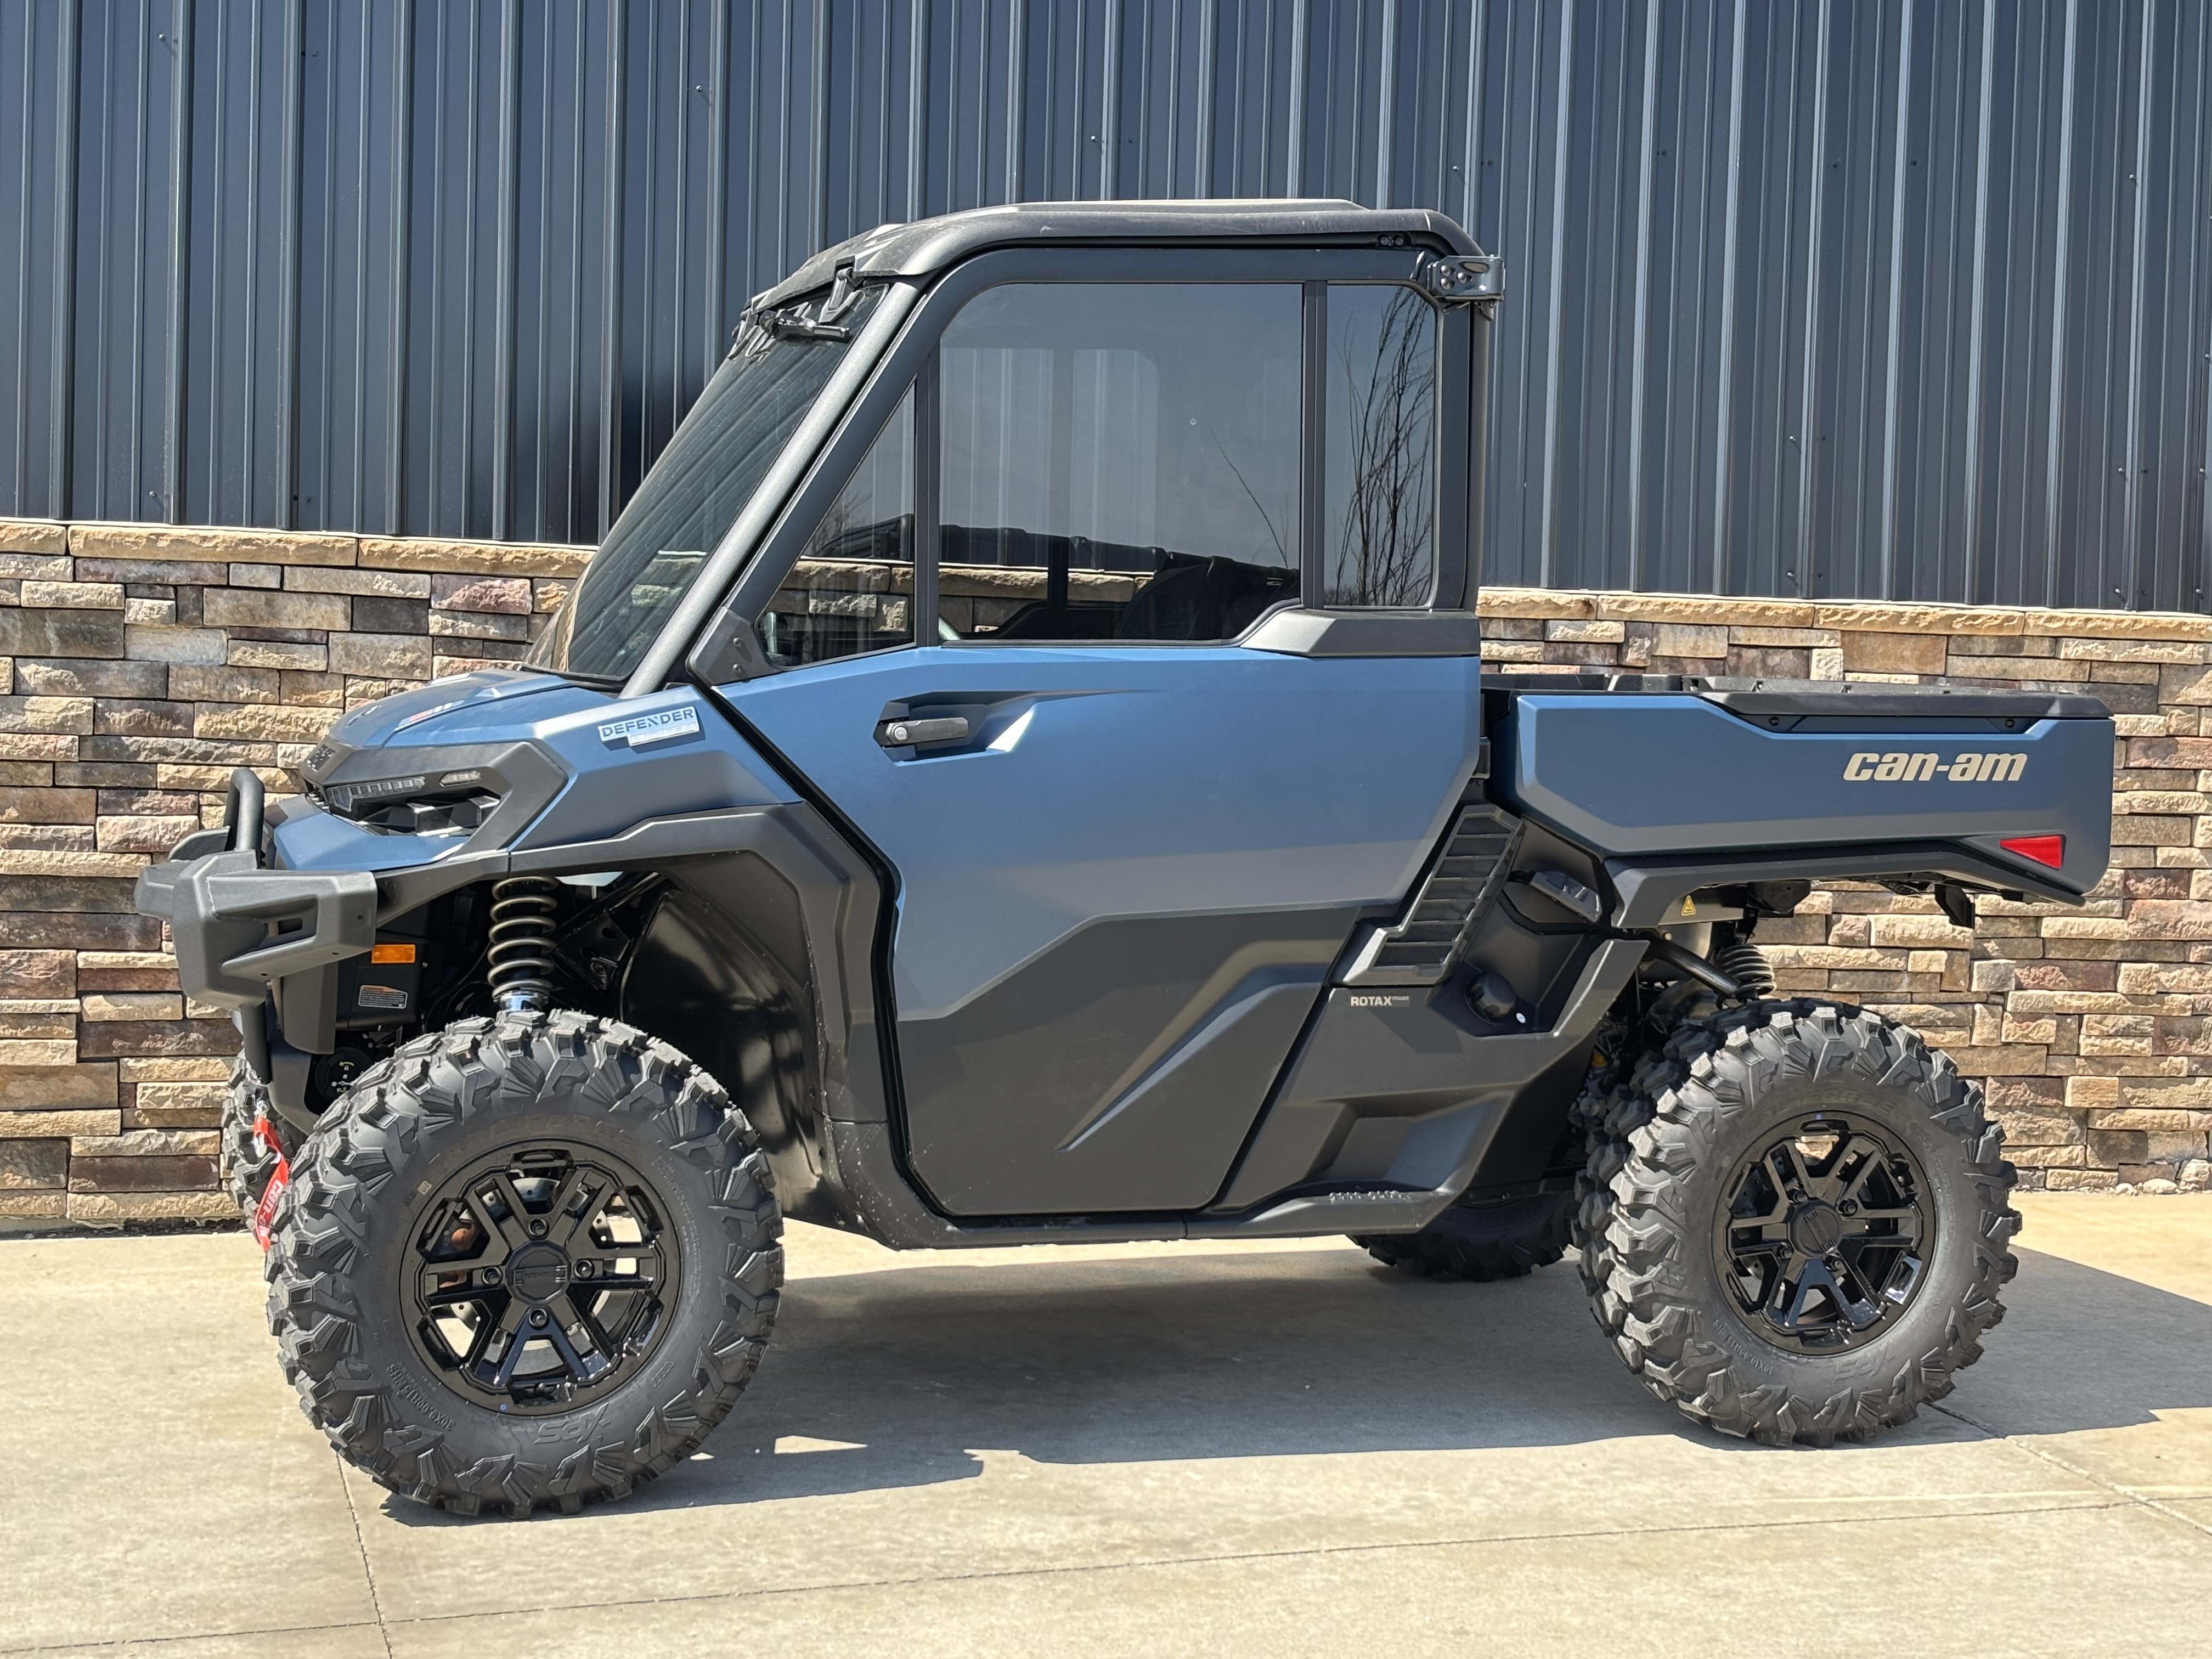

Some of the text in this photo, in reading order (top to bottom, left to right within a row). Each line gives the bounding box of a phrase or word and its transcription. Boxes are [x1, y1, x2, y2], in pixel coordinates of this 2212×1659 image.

[602, 709, 694, 737] DEFENDER
[1842, 752, 2028, 782] can-am
[1350, 996, 1393, 1007] ROTAX
[532, 1403, 611, 1445] XPS
